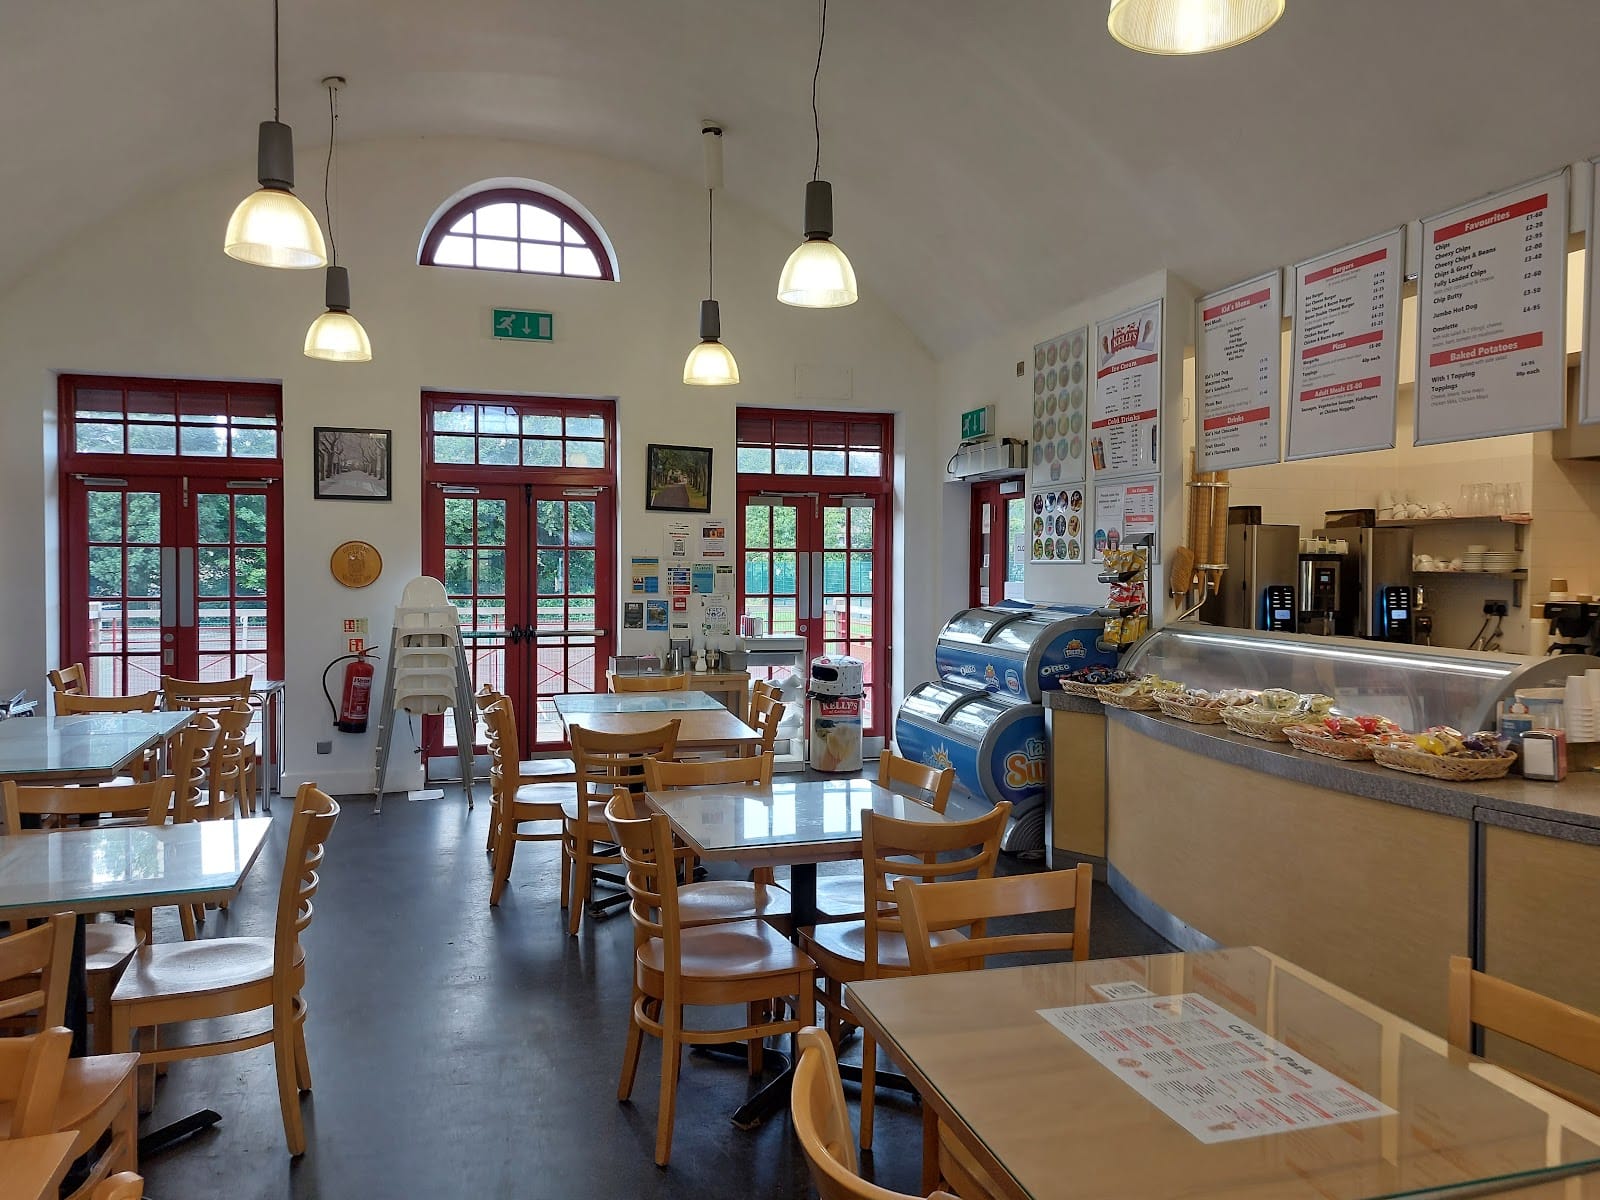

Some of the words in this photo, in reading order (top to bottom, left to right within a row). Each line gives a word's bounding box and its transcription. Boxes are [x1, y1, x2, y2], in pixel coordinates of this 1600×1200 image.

[1464, 211, 1510, 232] Favourites
[1435, 242, 1450, 251] Chips
[1435, 250, 1454, 260] Cheesy
[1456, 244, 1471, 255] Chips
[1434, 258, 1454, 270] Cheesy
[1455, 254, 1471, 264] Chips
[1478, 246, 1496, 256] Beans
[1332, 263, 1354, 274] Burgers
[1434, 268, 1449, 279] Chips
[1456, 263, 1473, 273] Gravy
[1434, 278, 1447, 288] Fully
[1448, 273, 1469, 284] Loaded
[1471, 268, 1486, 278] Chips
[1433, 296, 1446, 304] Chip
[1447, 292, 1462, 301] Butty
[1222, 303, 1234, 314] Kid's
[1235, 299, 1250, 309] Menu
[1433, 309, 1451, 318] Jumbo
[1466, 303, 1478, 312] Dog
[1433, 323, 1458, 332] Omelette
[1113, 331, 1138, 348] KELLY'S
[1450, 348, 1476, 362] Baked
[1478, 342, 1518, 356] Potatoes
[1120, 361, 1137, 370] Cream
[1451, 370, 1476, 380] Topping
[1315, 388, 1329, 397] Adult
[1330, 384, 1345, 395] Meals
[1432, 383, 1458, 392] Toppings
[1121, 414, 1140, 424] Drinks
[1228, 415, 1244, 424] Drinks
[1041, 664, 1070, 675] OREO
[822, 702, 858, 710] KELLY'S
[1280, 1056, 1312, 1075] Park
